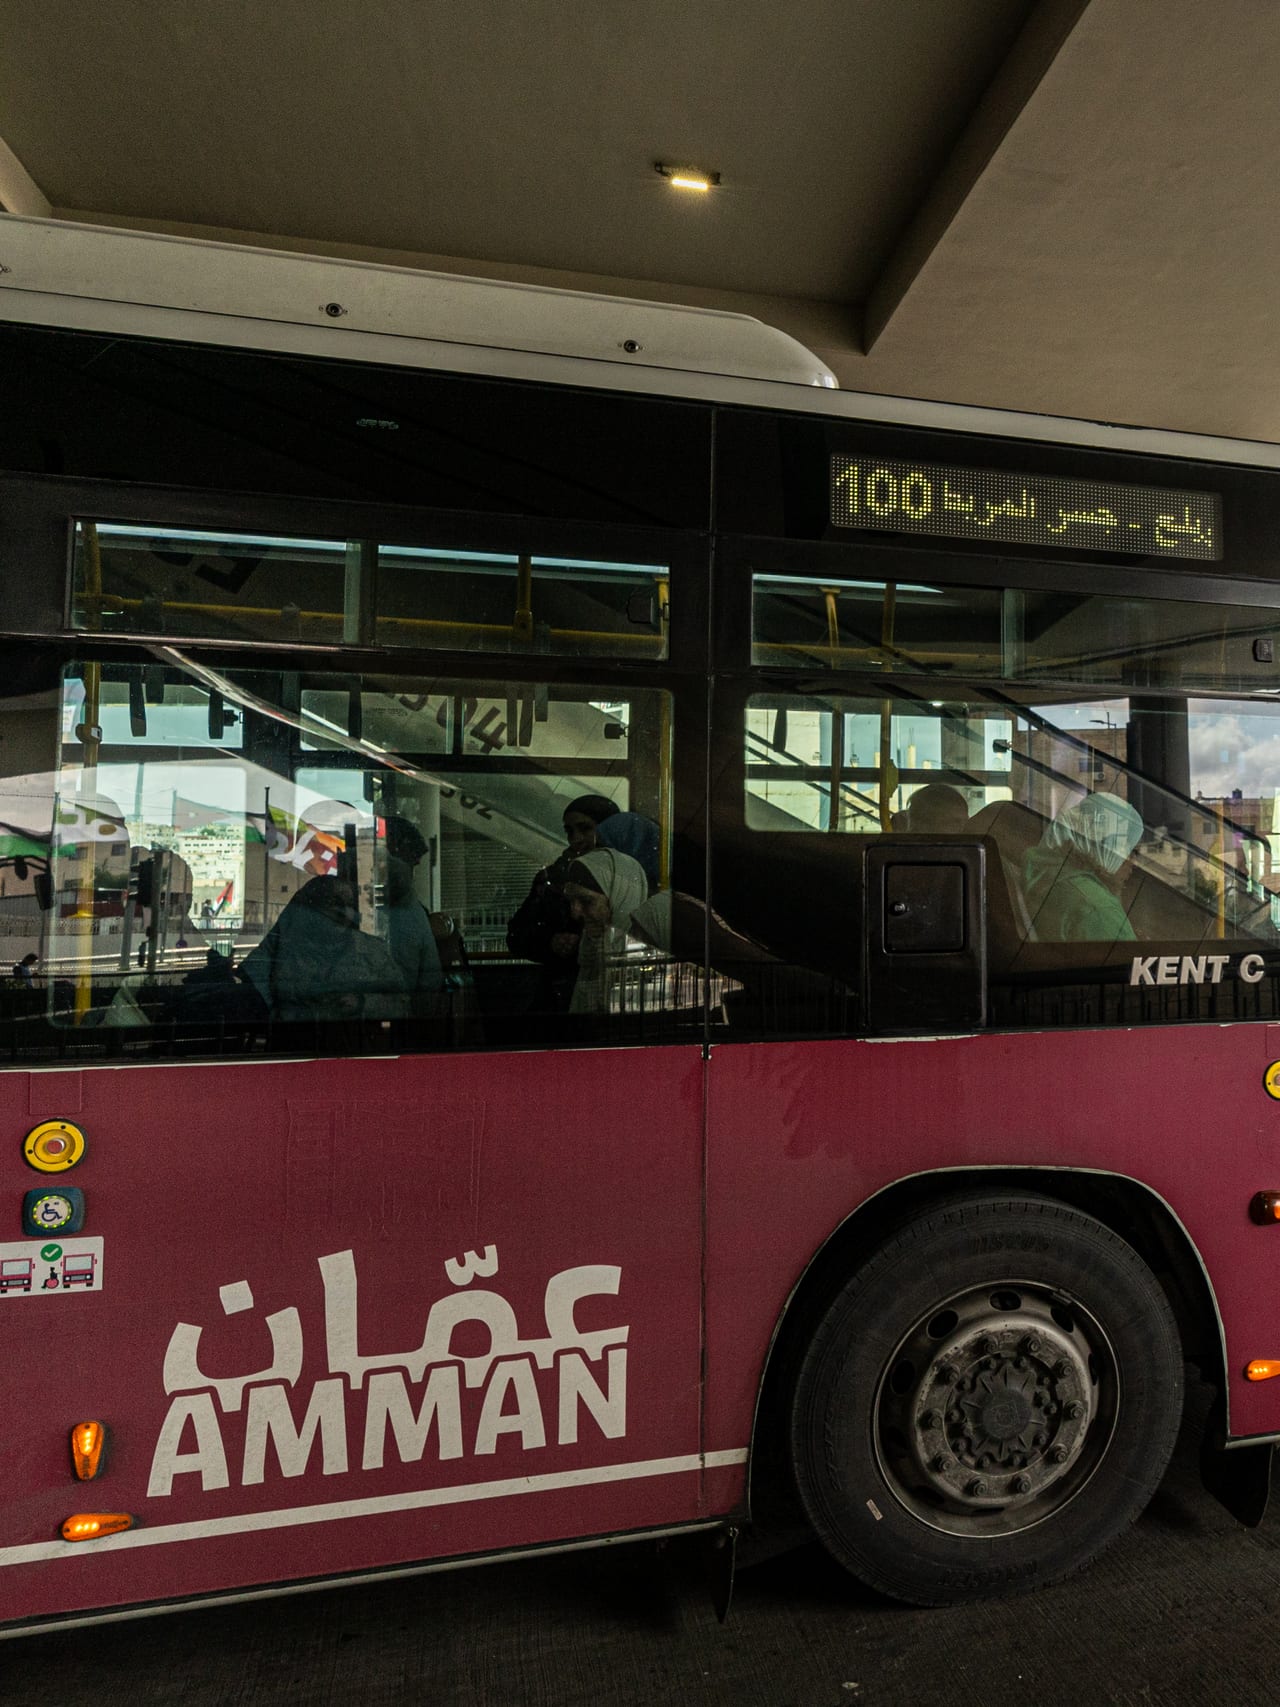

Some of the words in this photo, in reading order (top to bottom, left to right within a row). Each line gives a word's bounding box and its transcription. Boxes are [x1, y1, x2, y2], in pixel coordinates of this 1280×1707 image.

[836, 465, 932, 519] 100
[1046, 508, 1118, 534] جسر
[1130, 955, 1230, 986] KENT
[1239, 954, 1265, 984] C
[146, 1348, 628, 1497] AMMAN
